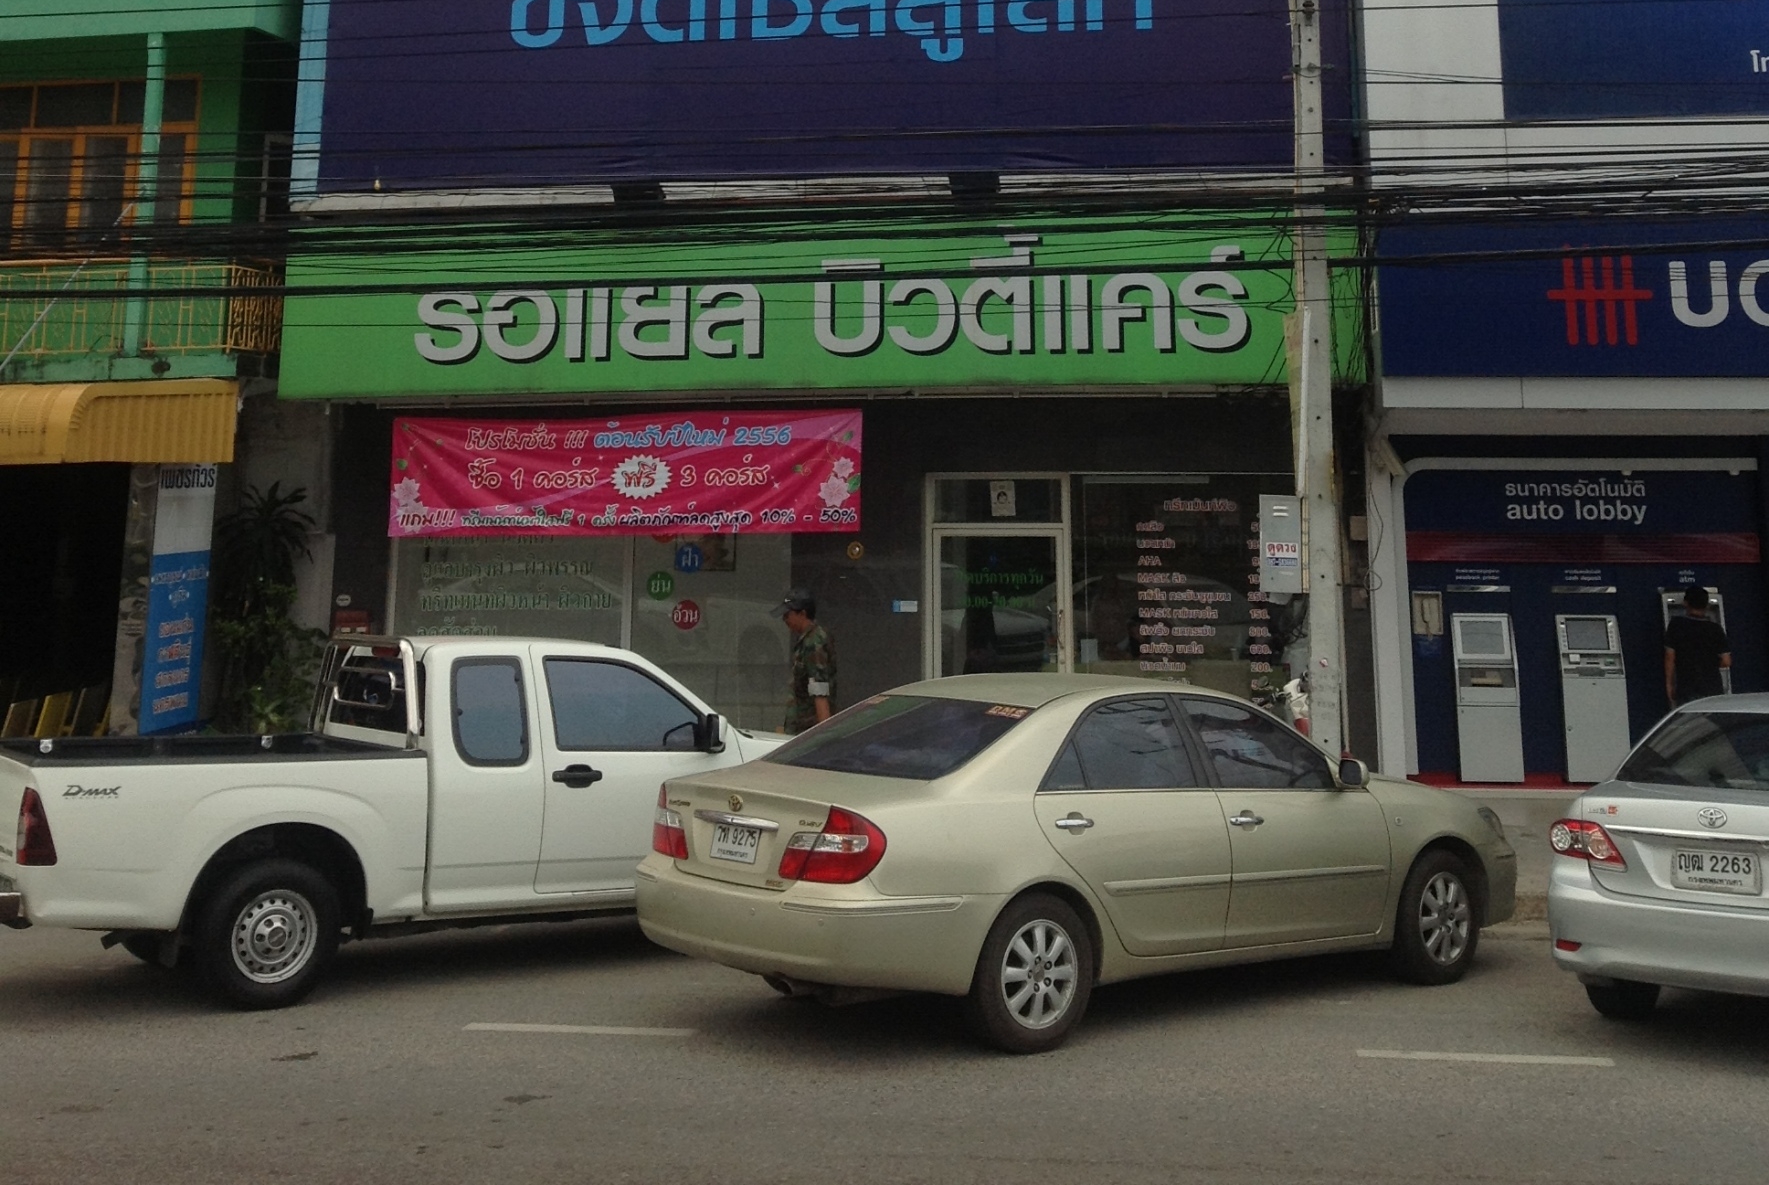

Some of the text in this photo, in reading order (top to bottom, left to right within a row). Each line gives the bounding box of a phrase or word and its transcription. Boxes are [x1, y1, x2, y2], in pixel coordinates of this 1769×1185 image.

[413, 224, 1252, 364] รอแยล บิวตี้แคร์
[464, 422, 556, 450] โปรโมชั่น
[593, 416, 728, 448] ต้อนรับปีใหม่
[733, 424, 792, 446] 2556
[467, 453, 772, 490] ซื้อ 1 คอร์ส ฟรี 3 คอร์ส
[1504, 478, 1646, 497] ธนาคารอัตโนมัติ
[761, 508, 796, 524] 10%
[820, 508, 858, 524] 50%
[1506, 499, 1647, 525] auto lobby
[1138, 556, 1162, 567] AHA
[651, 573, 671, 593] ย่น
[1138, 572, 1171, 584] MASK
[672, 604, 699, 624] อ้วน
[1138, 607, 1172, 619] MASK
[731, 827, 757, 848] 9275
[1709, 855, 1752, 875] 2263
